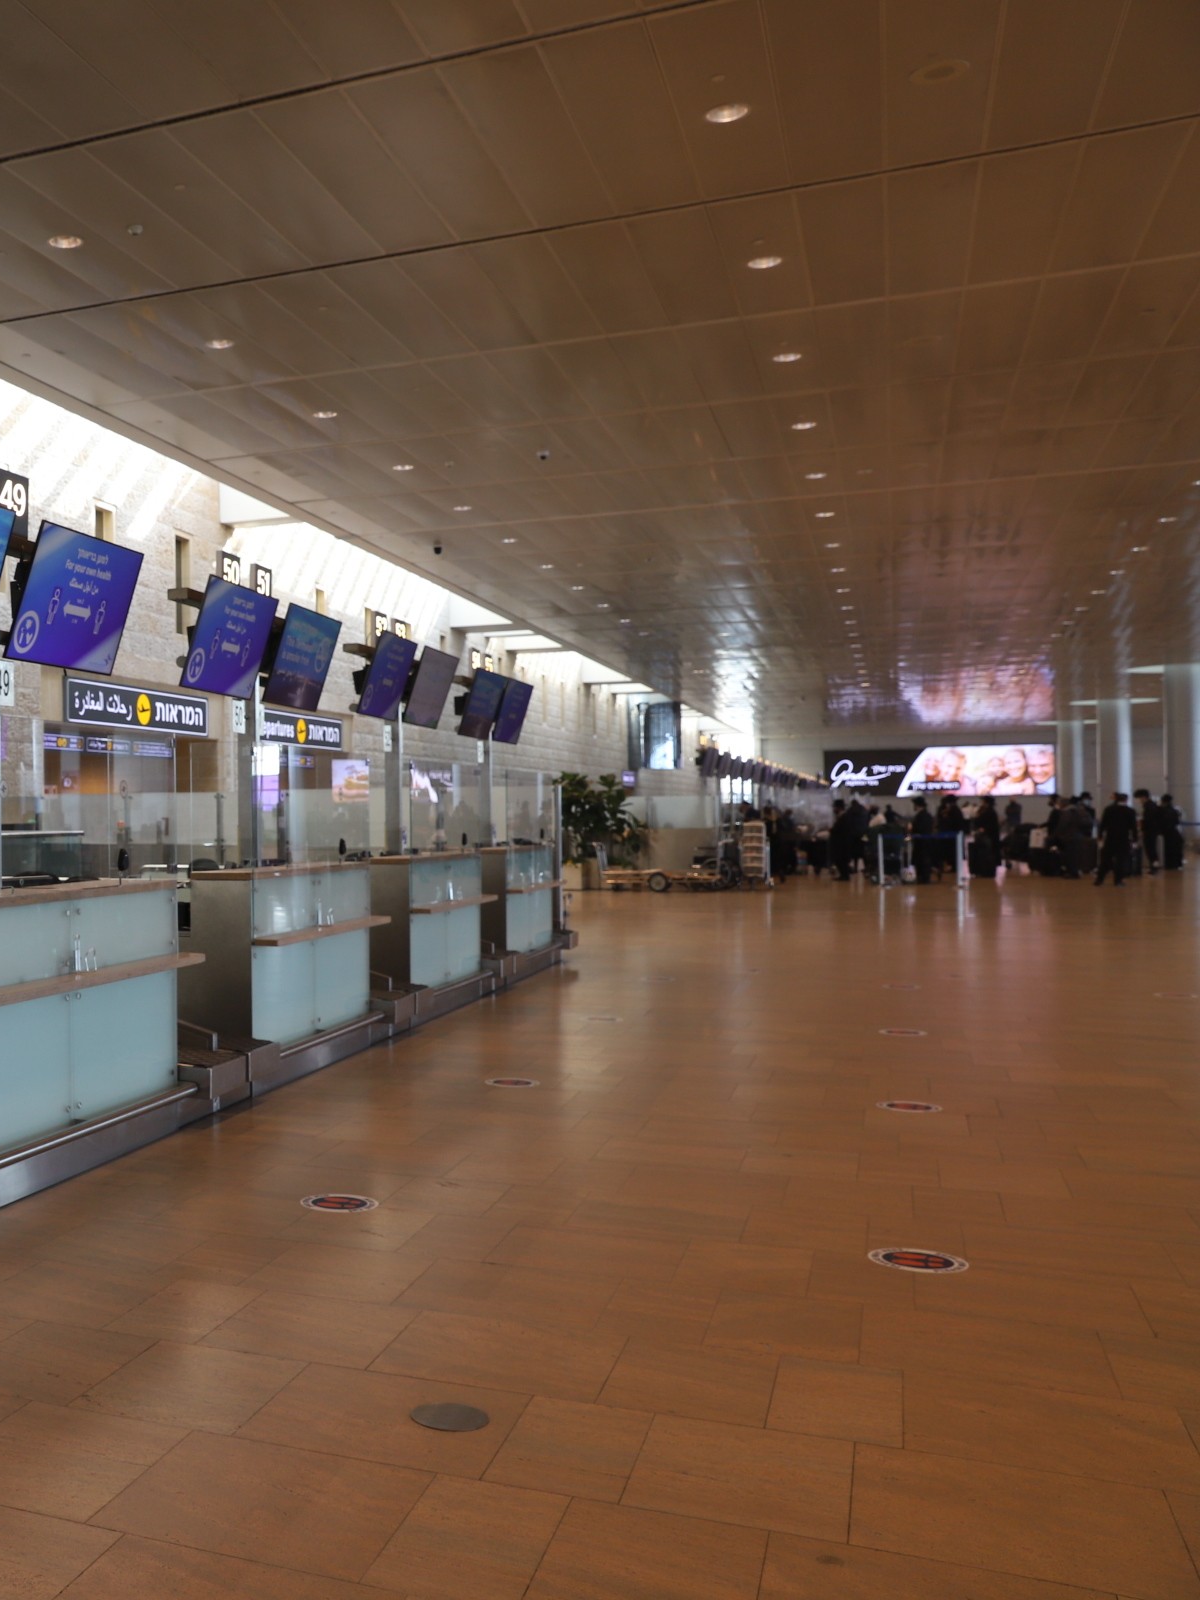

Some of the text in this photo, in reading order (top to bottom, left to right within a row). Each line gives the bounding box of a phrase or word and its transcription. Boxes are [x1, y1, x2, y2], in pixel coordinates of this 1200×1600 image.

[0, 479, 26, 517] 49
[223, 557, 240, 585] 50
[257, 569, 271, 597] 51
[106, 694, 133, 721] رحلات
[155, 702, 203, 726] המראות
[263, 720, 294, 739] epartures
[308, 724, 340, 743] המראות
